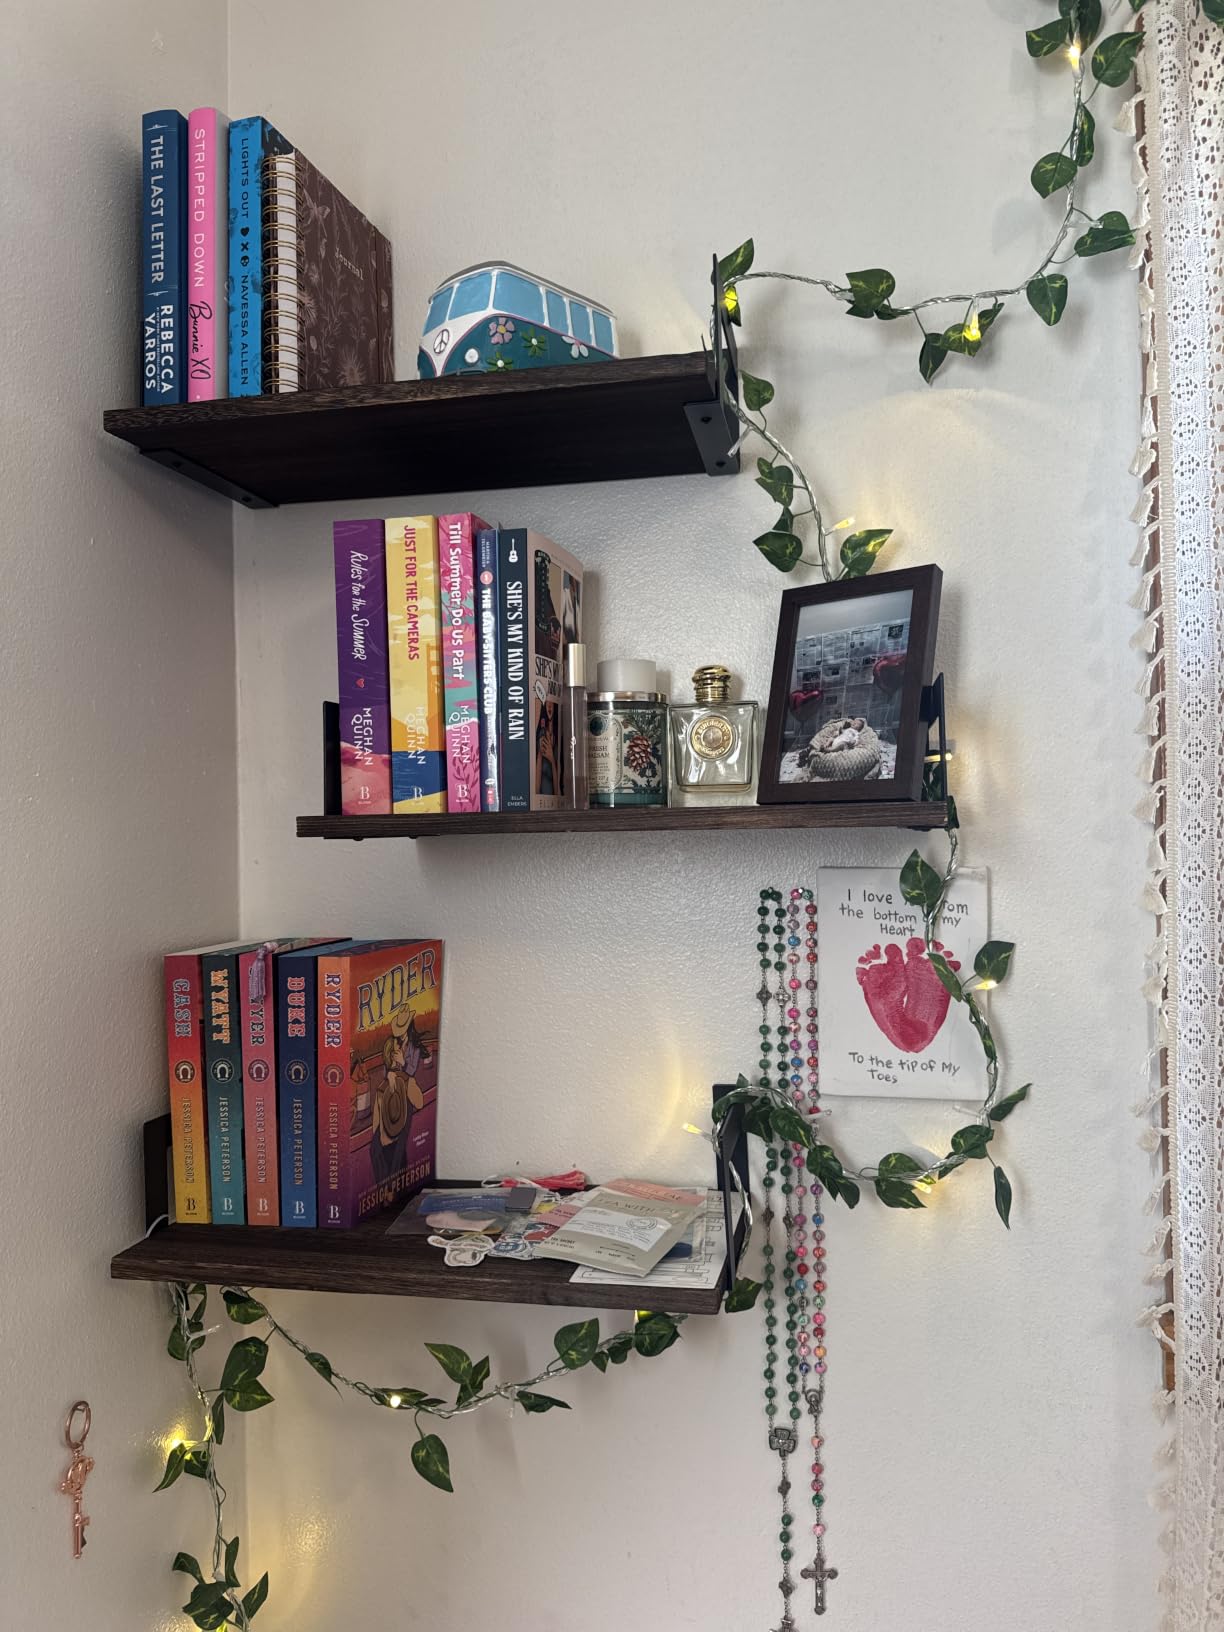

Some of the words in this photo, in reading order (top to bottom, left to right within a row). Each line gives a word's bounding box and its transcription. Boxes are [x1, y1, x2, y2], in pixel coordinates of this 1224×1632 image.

[150, 136, 164, 169] THE
[194, 128, 206, 222] STRIPPED
[151, 174, 164, 216] LAST
[151, 223, 164, 284] LETTER
[193, 233, 205, 288] DOWN
[241, 275, 249, 338] NAVESSA
[189, 301, 212, 354] Bunnie
[145, 312, 156, 389] YARROS
[160, 304, 174, 394] REBECCA
[190, 358, 211, 379] XO
[404, 525, 416, 553] JUST
[449, 522, 462, 544] Till
[350, 550, 368, 581] Rules
[405, 556, 417, 578] FOR
[449, 547, 462, 605] Summer
[352, 597, 366, 612] the
[406, 580, 417, 602] THE
[482, 588, 492, 609] THE
[506, 581, 523, 620] SHE'S
[406, 604, 419, 661] CAMERAS
[452, 608, 463, 625] Do
[507, 624, 524, 644] MY
[452, 630, 464, 646] Us
[482, 611, 494, 685] BABY-SITTERS
[452, 650, 465, 680] Part
[507, 648, 524, 681] KIND
[484, 686, 493, 715] CLUB
[508, 686, 524, 704] OF
[351, 714, 364, 760] QUINN
[362, 708, 374, 766] MEGHAN
[405, 713, 417, 759] QUINN
[416, 706, 426, 764] MEGHAN
[449, 712, 461, 757] QUINN
[460, 705, 471, 764] MEGHAN
[508, 708, 525, 740] RAIN
[360, 786, 370, 799] B
[412, 786, 422, 800] B
[457, 784, 468, 797] B
[839, 901, 864, 918] the
[873, 908, 917, 924] bottom
[942, 916, 961, 928] my
[848, 889, 851, 901] I
[863, 890, 893, 903] love
[943, 900, 968, 915] rom
[880, 923, 916, 938] Heart
[173, 979, 192, 1037] CASH
[211, 969, 230, 1044] WYATT
[287, 977, 305, 1037] DUKE
[357, 948, 436, 1032] RYDER
[324, 973, 342, 1048] RYDER
[848, 1052, 864, 1064] To
[869, 1055, 893, 1069] the
[898, 1059, 918, 1072] tip
[921, 1059, 936, 1072] of
[942, 1062, 961, 1076] My
[867, 1069, 898, 1084] Toes
[182, 1098, 192, 1133] JESSICA
[219, 1097, 229, 1133] JESSICA
[256, 1097, 265, 1133] JESSICA
[293, 1098, 302, 1135] JESSICA
[329, 1103, 338, 1139] JESSICA
[184, 1136, 194, 1183] PETERSON
[221, 1136, 231, 1182] PETERSON
[256, 1136, 267, 1183] PETERSON
[294, 1138, 303, 1185] PETERSON
[329, 1142, 338, 1190] PETERSON
[187, 1198, 196, 1211] B
[224, 1198, 232, 1211] B
[259, 1198, 268, 1211] B
[358, 1184, 388, 1216] JESSICA
[391, 1161, 431, 1193] PETERSON
[295, 1201, 304, 1214] B
[330, 1205, 339, 1218] B
